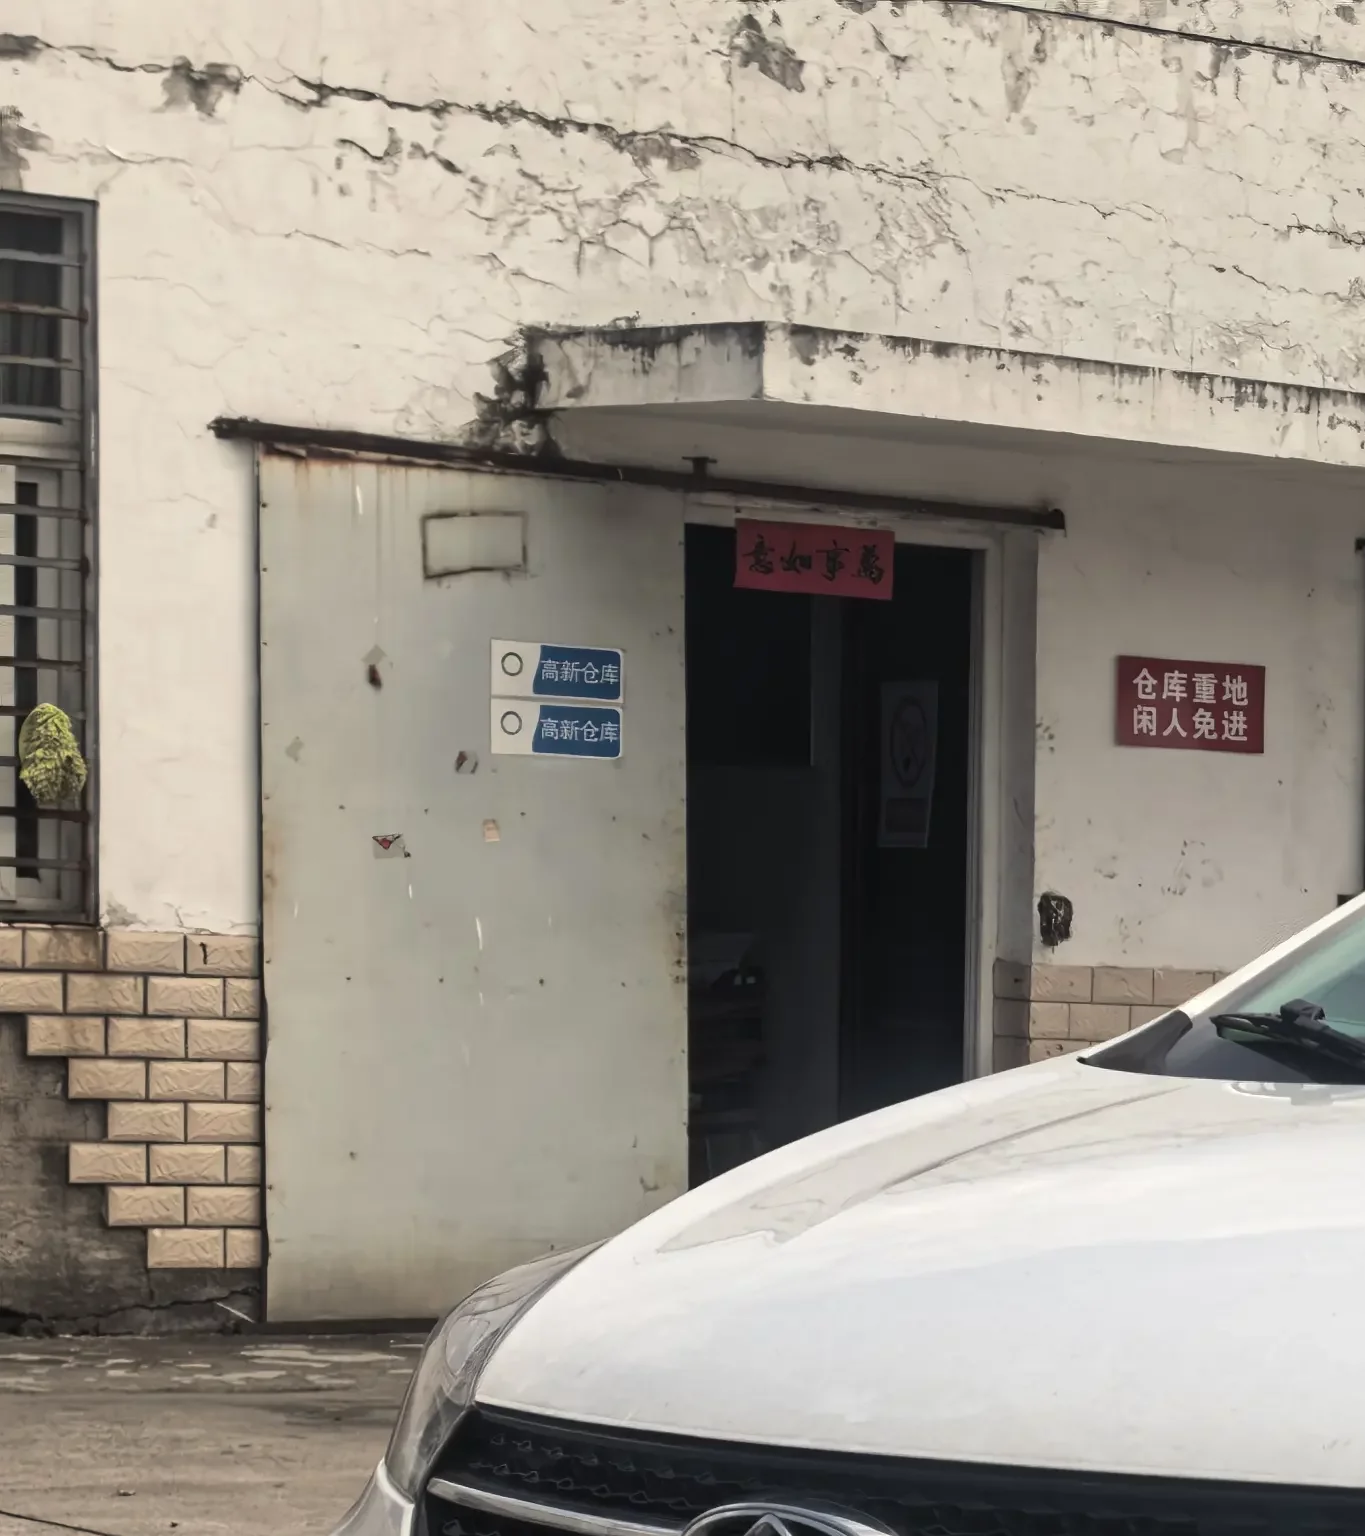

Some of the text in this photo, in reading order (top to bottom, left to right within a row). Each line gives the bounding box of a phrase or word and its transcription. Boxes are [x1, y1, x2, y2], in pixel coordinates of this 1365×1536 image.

[540, 659, 620, 685] 高新仓库
[1132, 667, 1249, 706] 仓库重地
[540, 717, 620, 743] 高新仓库
[1132, 704, 1248, 741] 闲人免进
